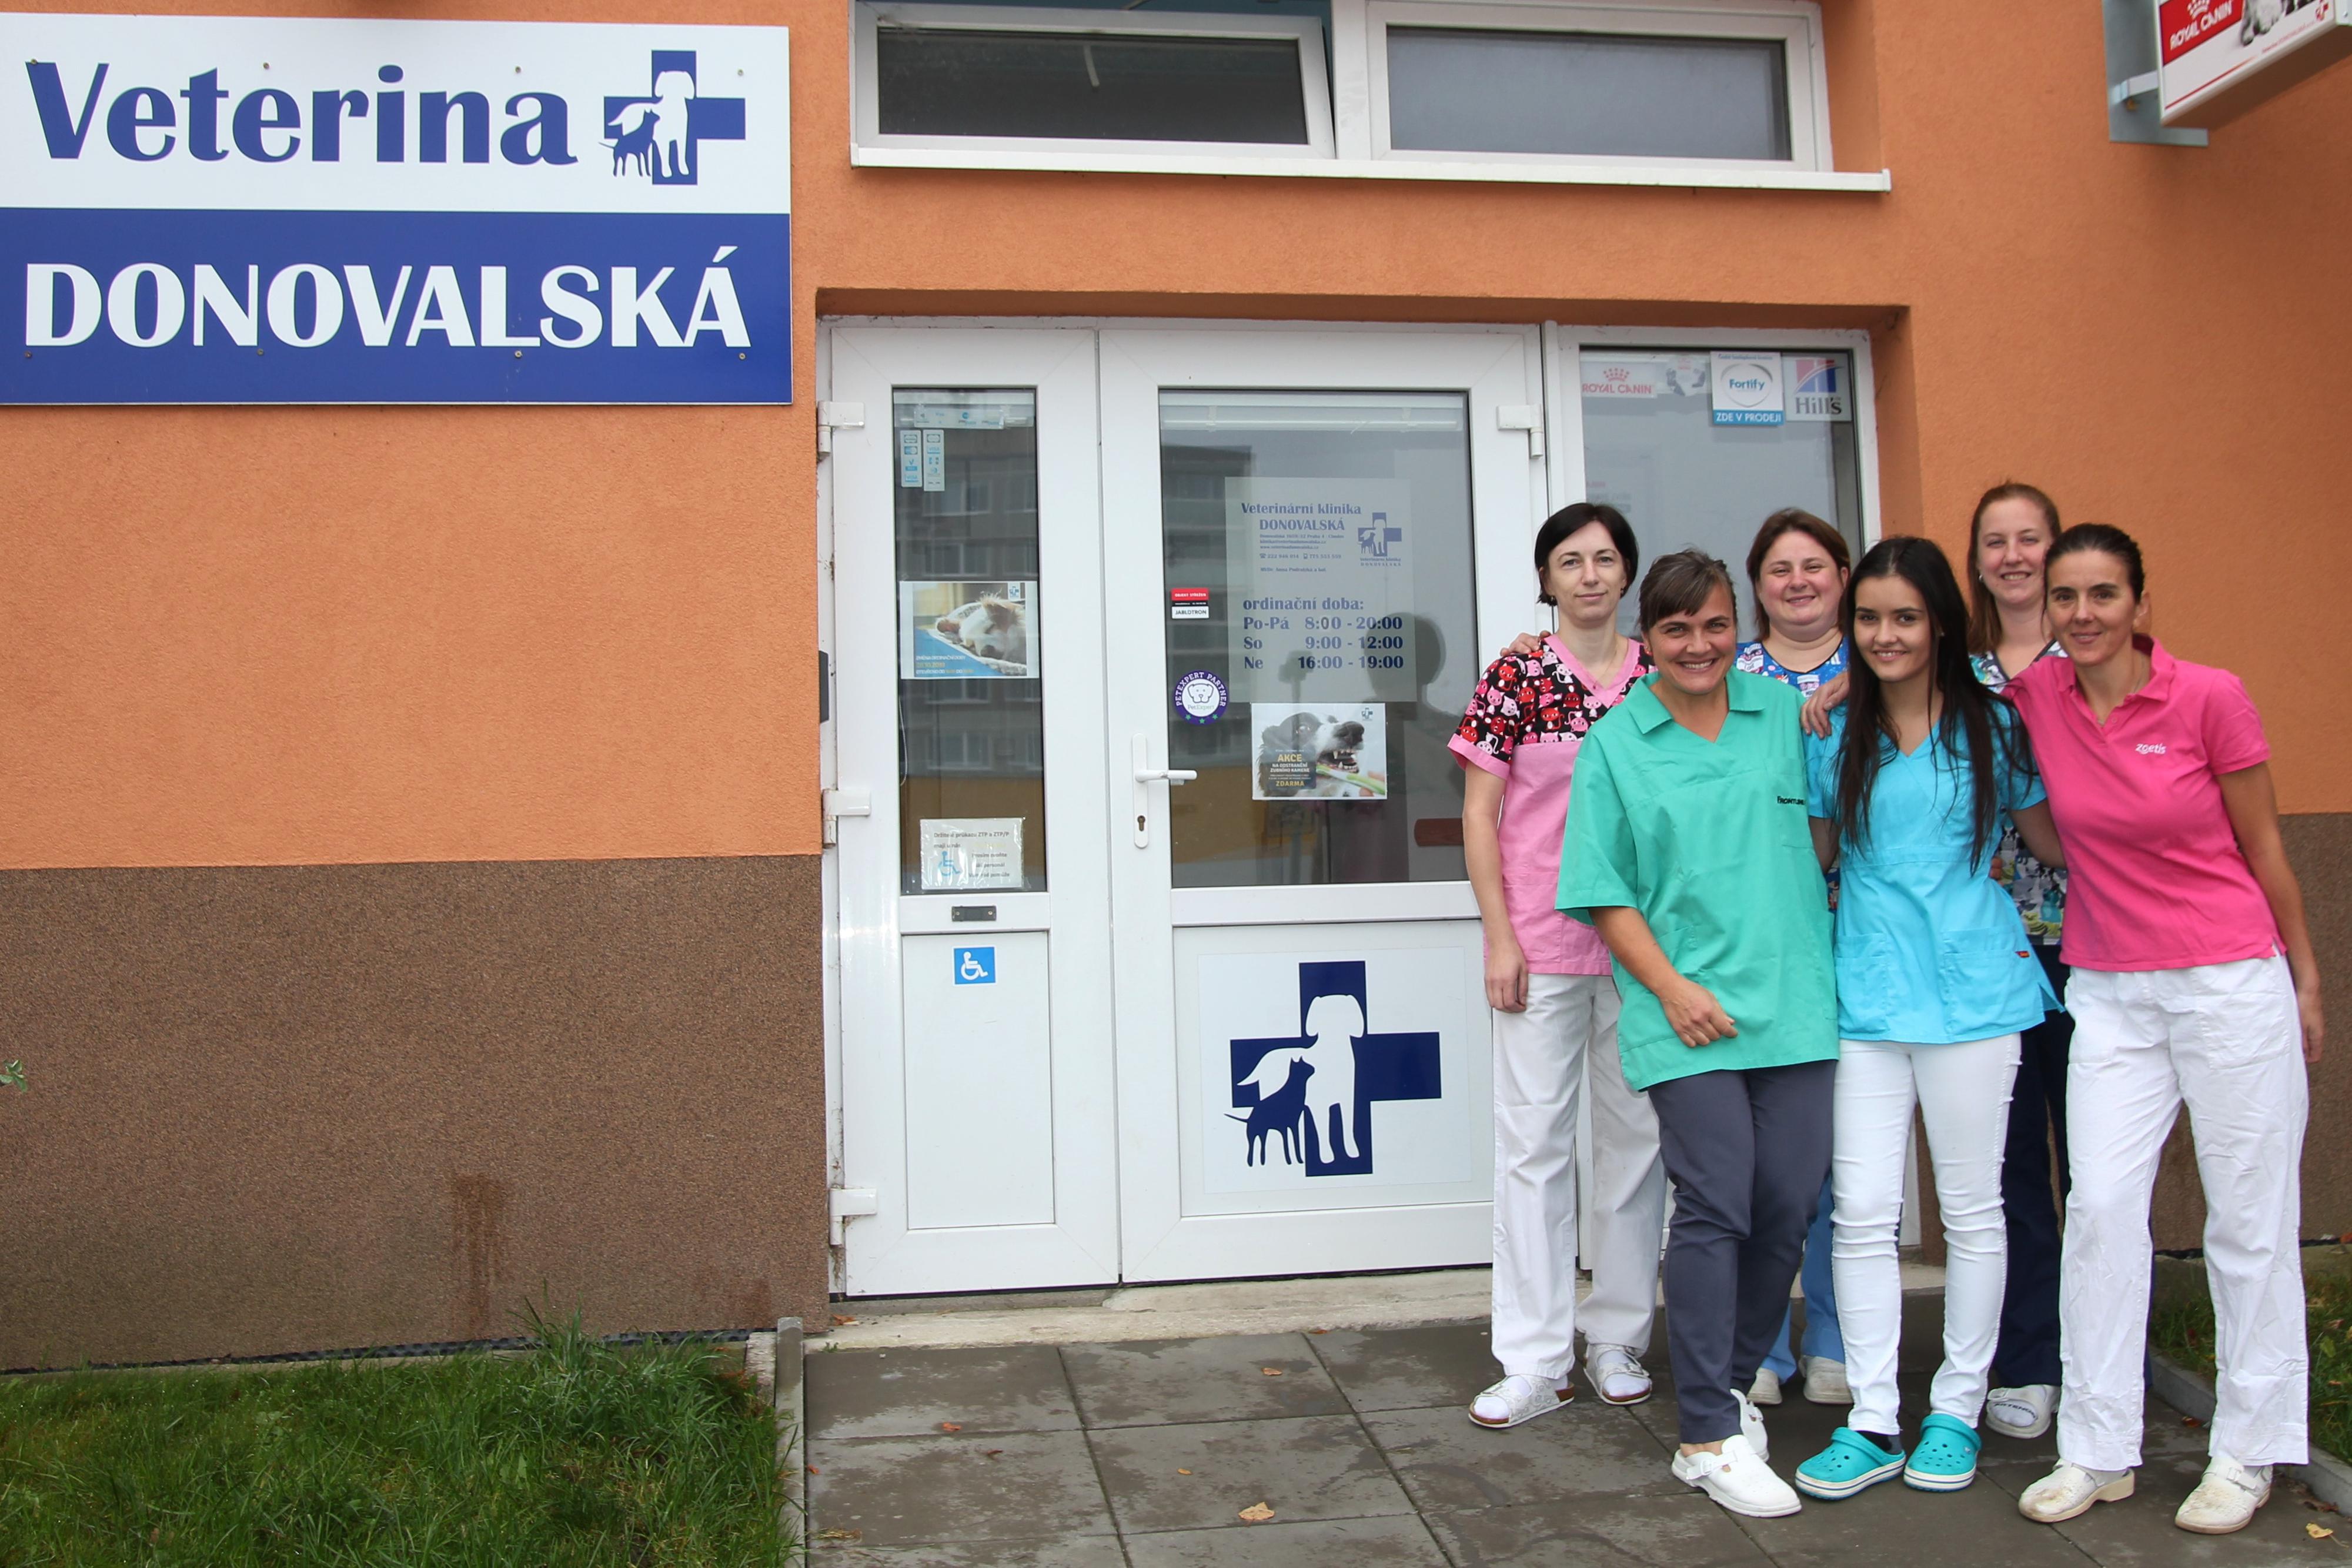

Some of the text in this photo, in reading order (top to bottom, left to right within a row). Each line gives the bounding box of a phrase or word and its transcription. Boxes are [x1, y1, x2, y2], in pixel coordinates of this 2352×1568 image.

[2170, 1, 2233, 51] ROYAL CANIN
[25, 61, 578, 165] Veterina
[25, 245, 751, 348] DONOVALSKÁ
[1582, 383, 1652, 394] ROYAL CANIN
[1729, 379, 1765, 390] Fortify
[1795, 397, 1842, 415] Hill's
[1716, 412, 1781, 422] ZDE V PRODEJI
[1241, 503, 1361, 514] Veterinární klinika
[1259, 517, 1345, 530] DONOVALSKÁ
[1243, 597, 1364, 610] ordinační doba:
[1243, 616, 1290, 630] Po-Pá
[1305, 616, 1342, 630] 8:00
[1356, 616, 1403, 630] 20:00
[1244, 636, 1263, 649] So
[1305, 636, 1342, 649] 9:00
[1358, 636, 1404, 649] 12:00
[1244, 656, 1264, 669] Ne
[1298, 656, 1342, 669] 16:00
[1359, 656, 1404, 668] 19:00
[1175, 672, 1227, 707] PETEXPERT PARTNER
[2135, 743, 2167, 755] zoetis
[1277, 754, 1302, 762] AKCE
